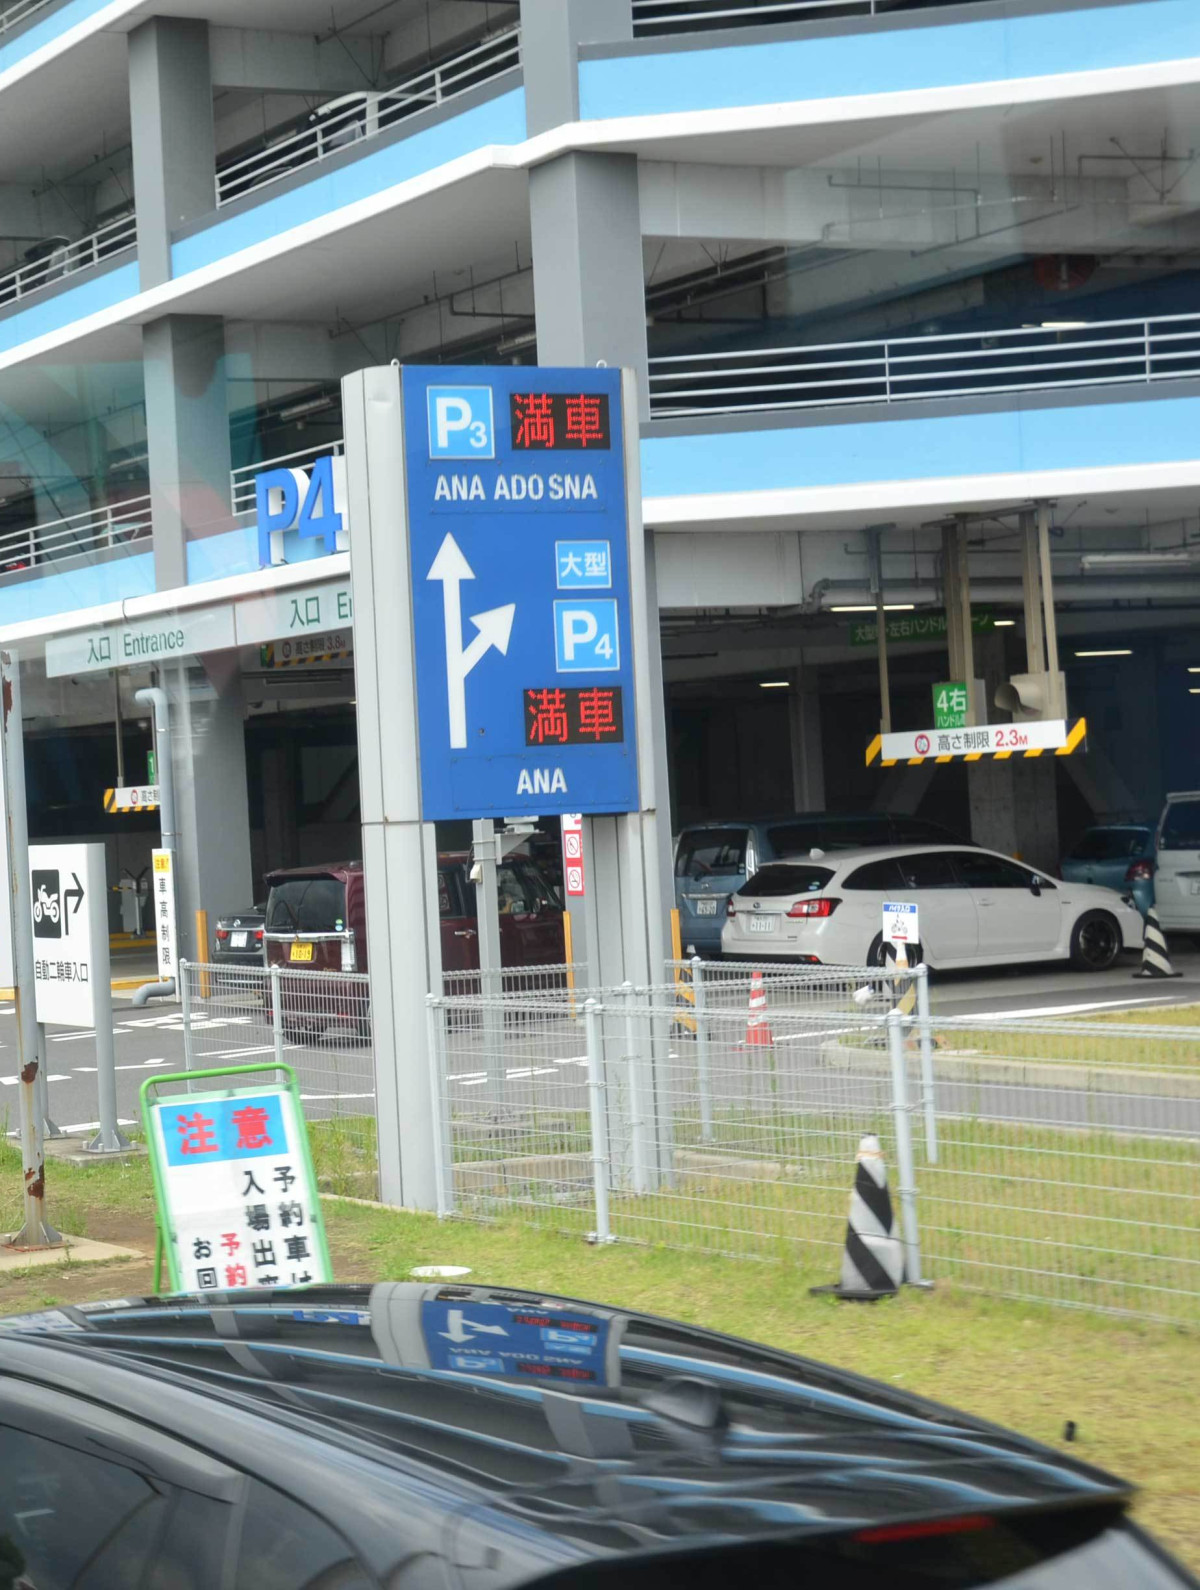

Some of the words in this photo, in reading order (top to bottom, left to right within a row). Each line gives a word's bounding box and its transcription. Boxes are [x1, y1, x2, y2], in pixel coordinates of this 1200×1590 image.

[436, 396, 488, 449] P3
[514, 393, 604, 448] 満車
[434, 474, 486, 501] ANA
[494, 474, 545, 501] ADO
[548, 473, 598, 500] SNA
[255, 455, 342, 567] P4
[560, 551, 608, 579] 大型
[290, 596, 320, 629] 入口
[87, 636, 112, 665] 入口
[124, 628, 185, 658] Entrance
[562, 609, 614, 662] P4
[528, 687, 617, 743] 満車
[937, 730, 990, 751] 高さ制限
[995, 729, 1028, 747] 2.3M
[516, 768, 568, 795] ANA
[35, 959, 89, 982] 自動二輪車入口
[176, 1105, 274, 1156] 注意
